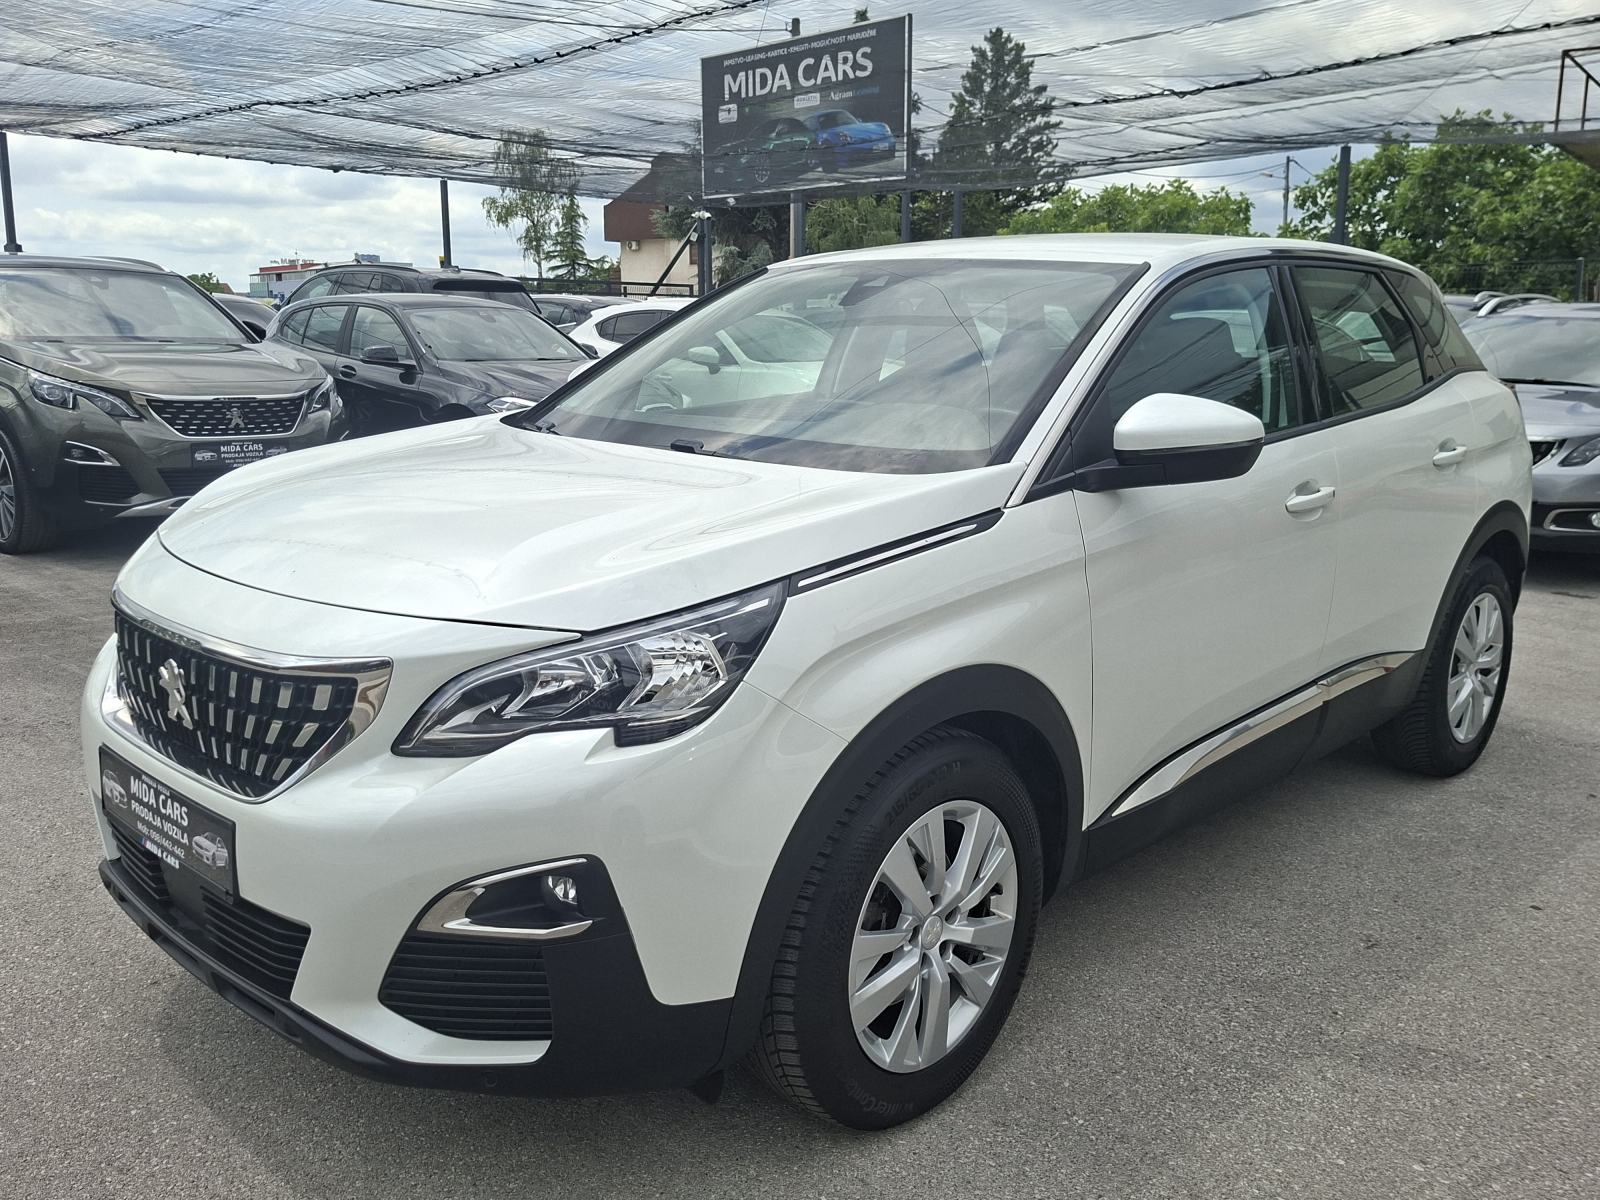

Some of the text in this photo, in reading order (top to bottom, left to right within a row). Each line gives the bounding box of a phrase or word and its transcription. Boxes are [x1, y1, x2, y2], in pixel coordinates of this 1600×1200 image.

[724, 64, 791, 101] MIDA
[797, 46, 873, 87] CARS
[220, 444, 241, 453] MIDA
[243, 443, 264, 451] CARS
[130, 775, 189, 827] MIDA CARS
[131, 800, 189, 846] PRODAJA VOZILA
